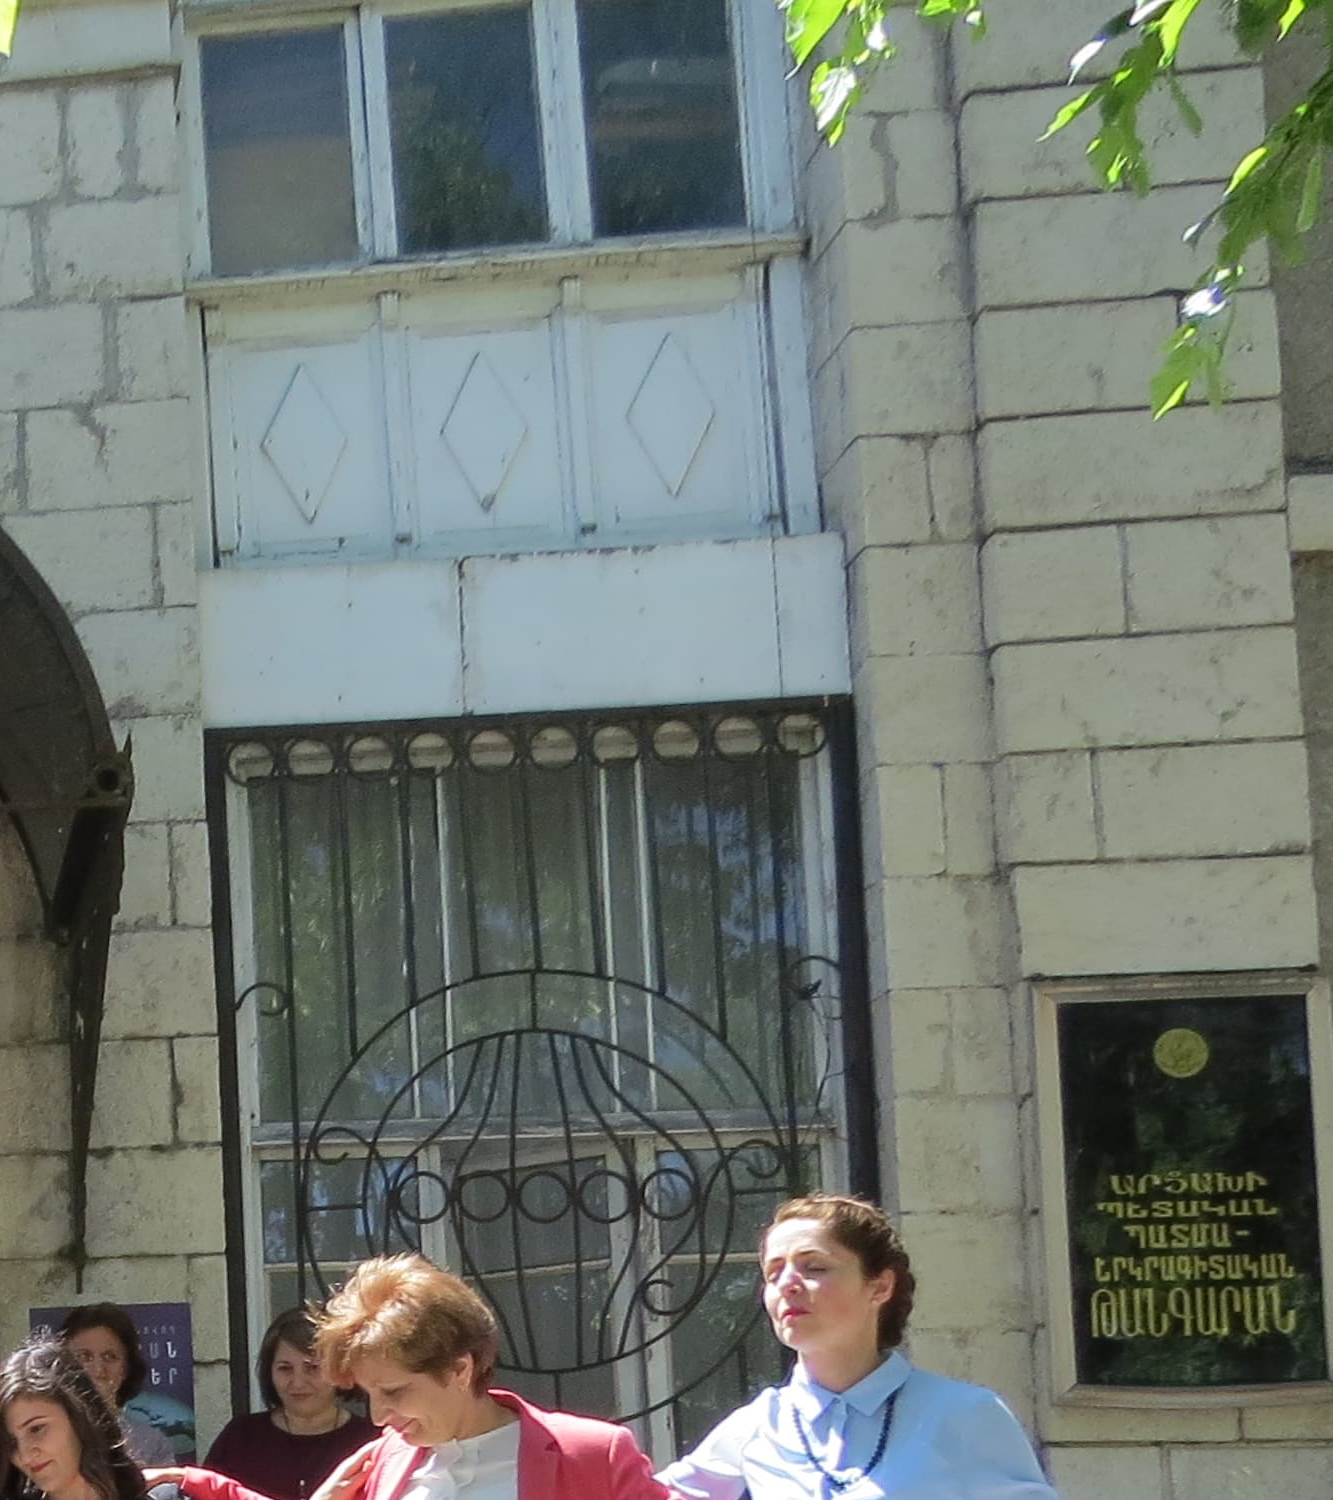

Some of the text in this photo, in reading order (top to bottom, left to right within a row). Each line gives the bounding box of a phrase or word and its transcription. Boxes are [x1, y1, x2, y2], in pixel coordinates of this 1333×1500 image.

[1108, 1170, 1270, 1197] ԱՐՑԱԽԻ
[1095, 1198, 1281, 1218] ՊԵՏԱԿԱՆ
[1094, 1252, 1296, 1283] ԵՐԿՐԱԳԻՏԱԿԱՆ
[1090, 1285, 1298, 1338] ԹԱՆԳԱՐԱՆ
